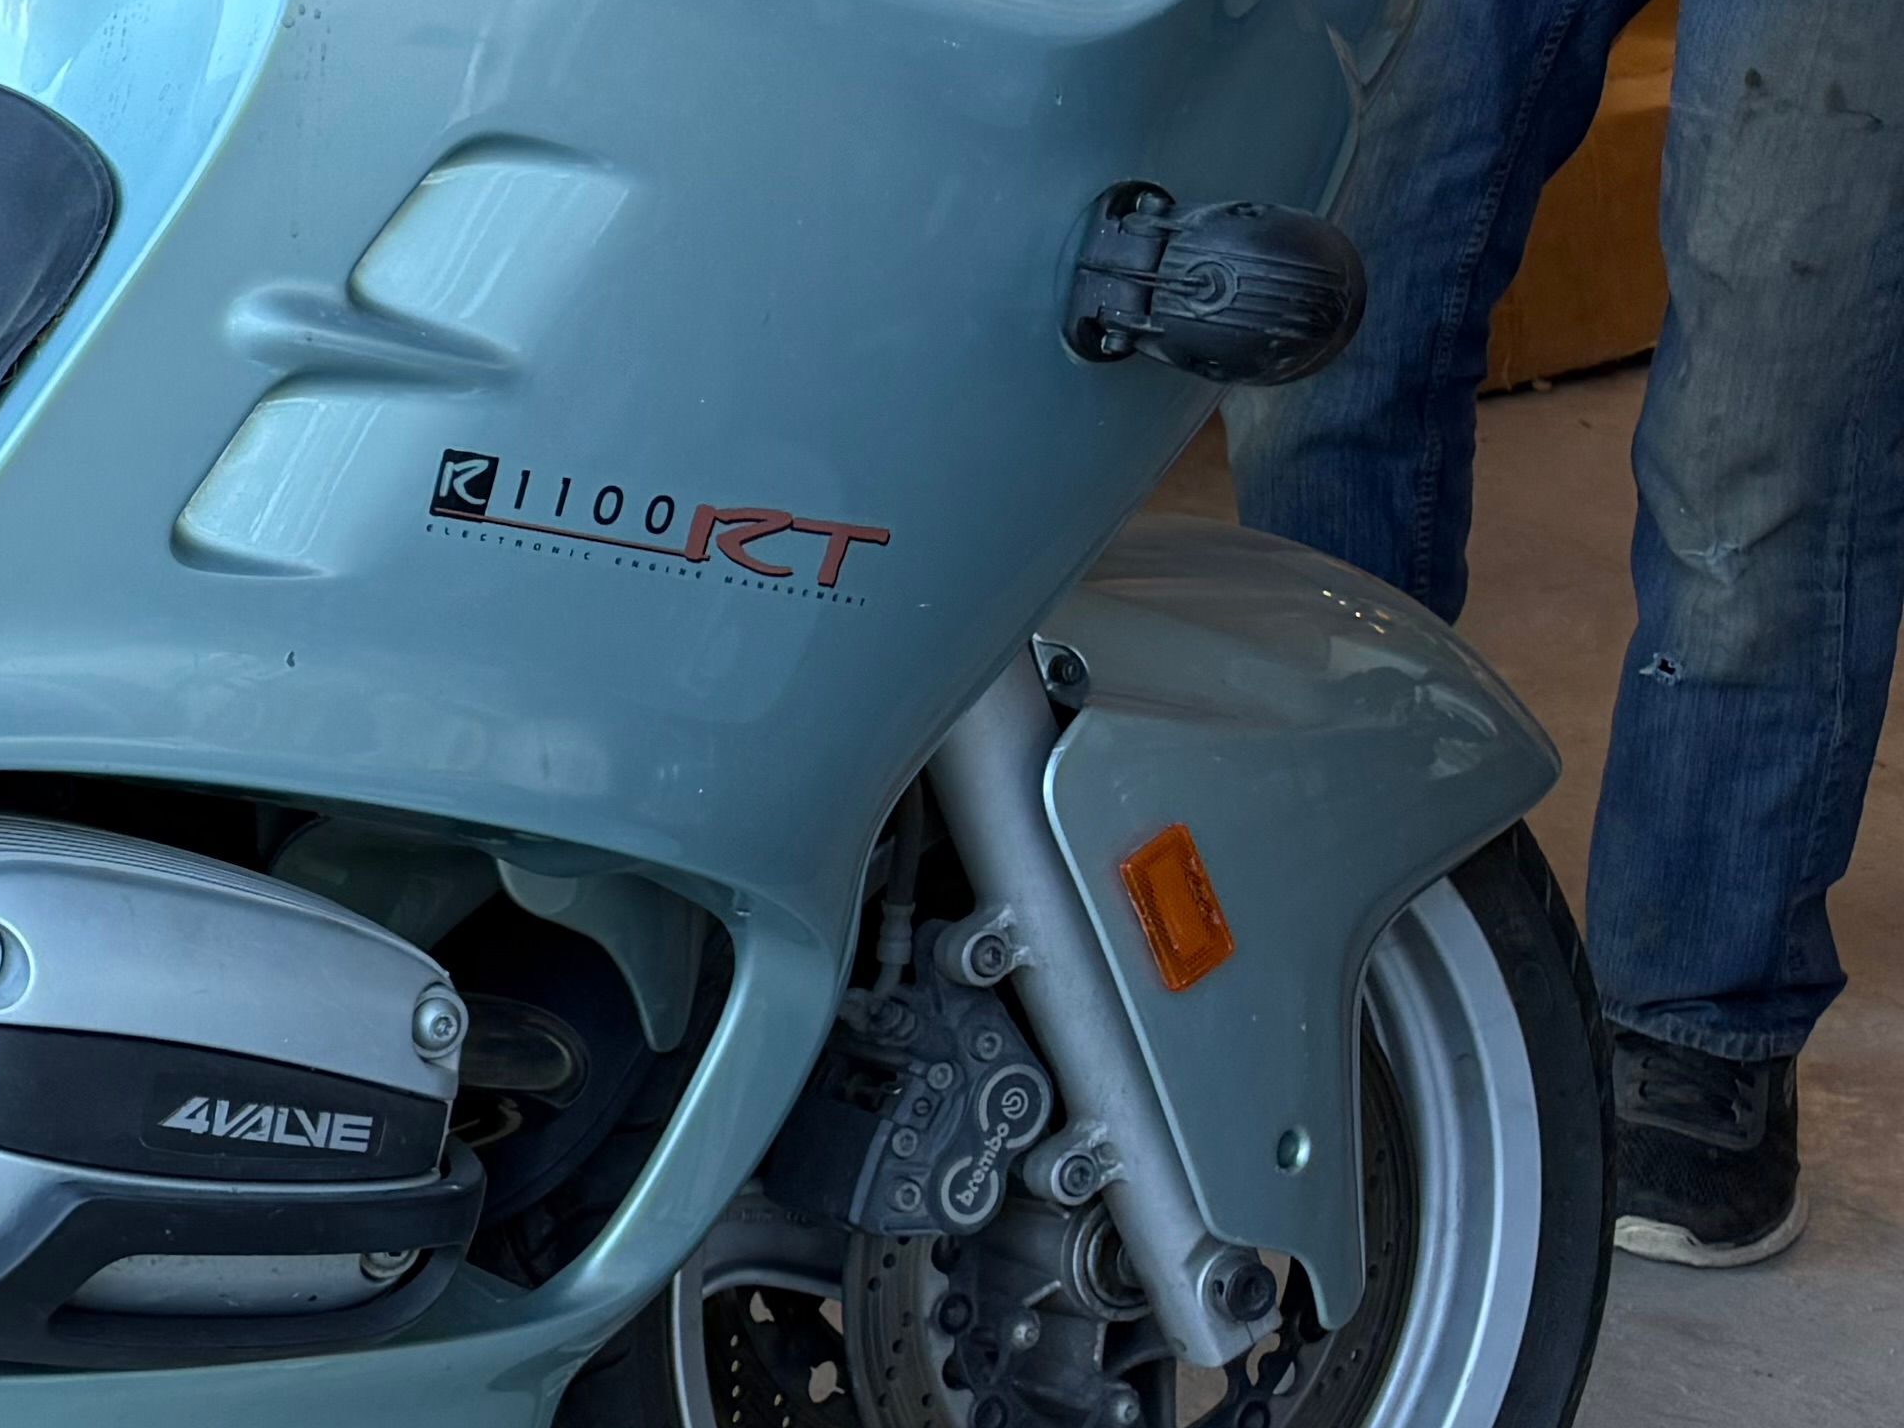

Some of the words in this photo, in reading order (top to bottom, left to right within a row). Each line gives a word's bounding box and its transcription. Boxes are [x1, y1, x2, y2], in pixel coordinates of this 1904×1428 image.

[426, 523, 592, 561] ELECTRONIC
[614, 556, 703, 580] ENGINE
[723, 575, 866, 607] MANAGEMENT
[158, 1095, 374, 1154] 4VALVE
[955, 1122, 1010, 1207] brembo
